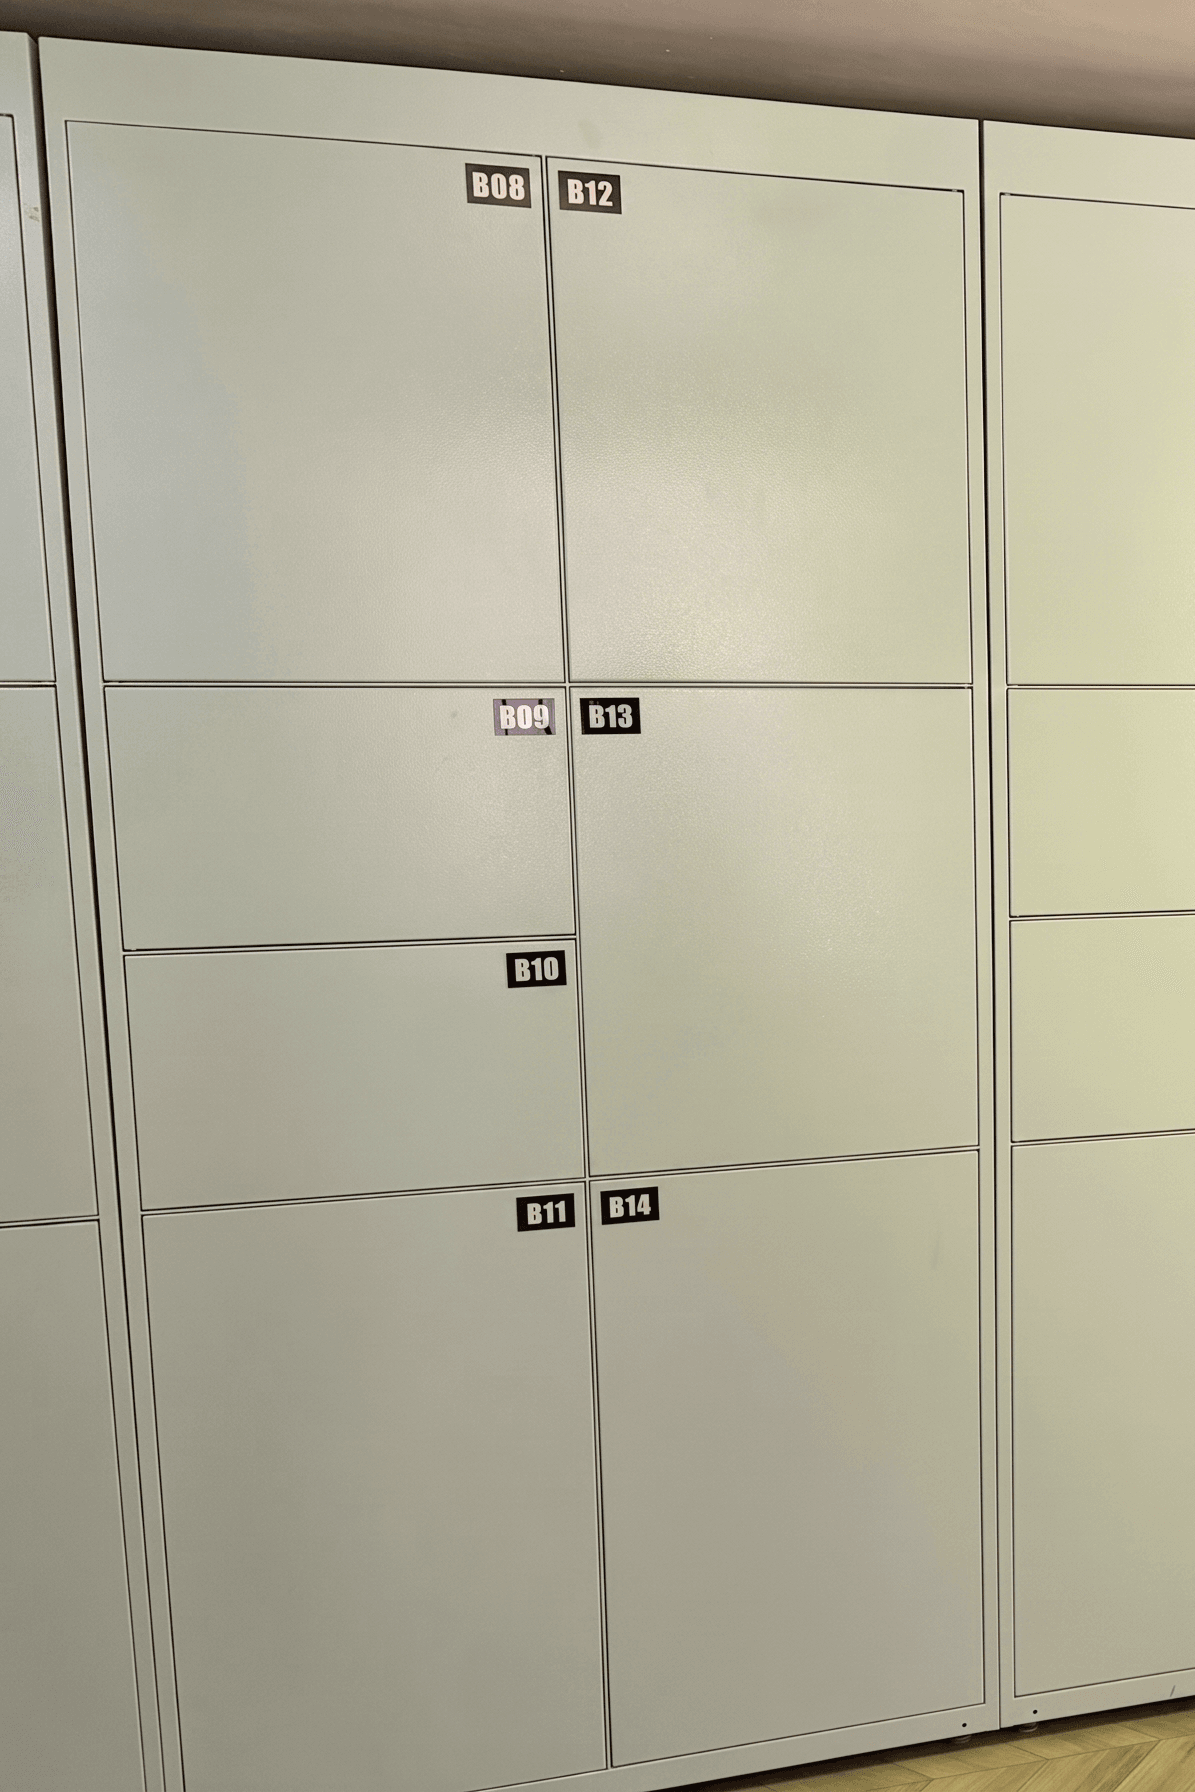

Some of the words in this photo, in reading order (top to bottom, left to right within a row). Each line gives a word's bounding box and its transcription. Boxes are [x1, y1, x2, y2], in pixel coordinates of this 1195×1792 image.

[473, 172, 525, 200] B08
[568, 179, 612, 206] B12
[500, 704, 549, 730] B09
[588, 704, 633, 728] B13
[515, 957, 558, 981] B10
[528, 1201, 565, 1224] B11
[610, 1194, 651, 1217] B14
